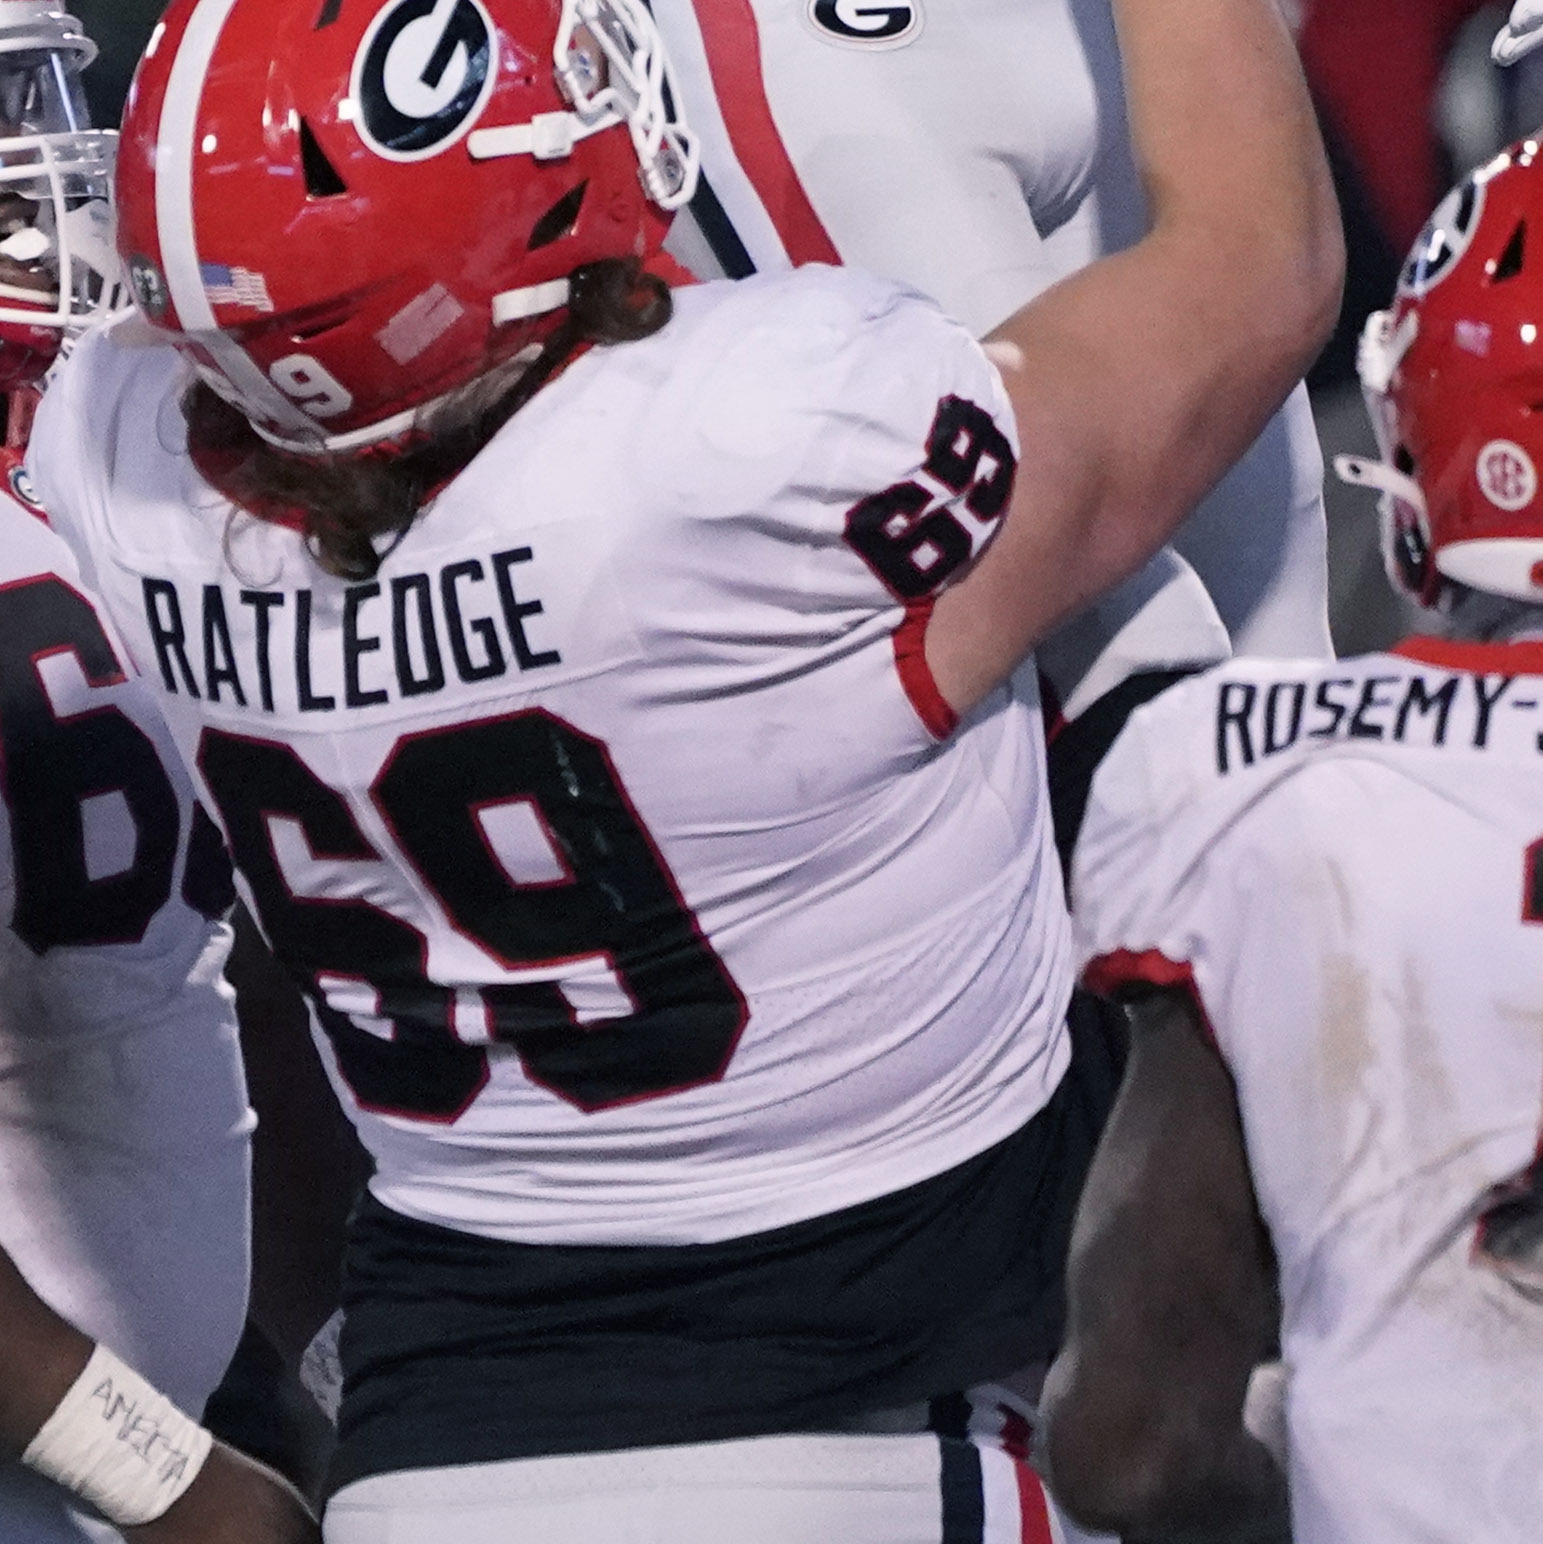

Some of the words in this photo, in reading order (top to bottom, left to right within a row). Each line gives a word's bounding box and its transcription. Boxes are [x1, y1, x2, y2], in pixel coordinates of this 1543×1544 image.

[270, 354, 353, 417] 9
[841, 392, 1018, 599] 69
[142, 545, 562, 713] RATLEDGE
[195, 706, 751, 1126] 69
